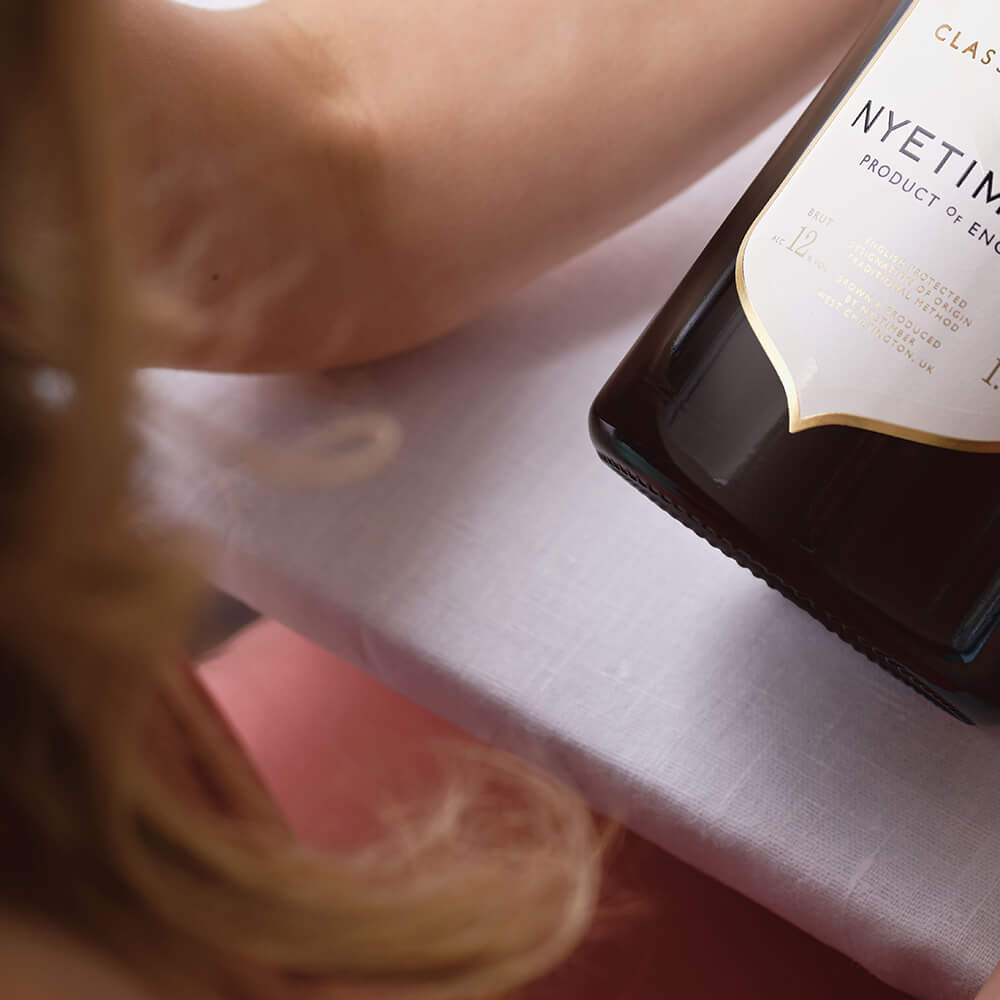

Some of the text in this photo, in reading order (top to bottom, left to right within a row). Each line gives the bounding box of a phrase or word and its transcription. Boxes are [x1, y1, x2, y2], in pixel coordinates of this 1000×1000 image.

[859, 153, 941, 208] PRODUCT
[946, 206, 963, 225] OF
[913, 298, 960, 333] METHOD
[933, 297, 974, 327] ORIGIN
[918, 359, 935, 374] UK
